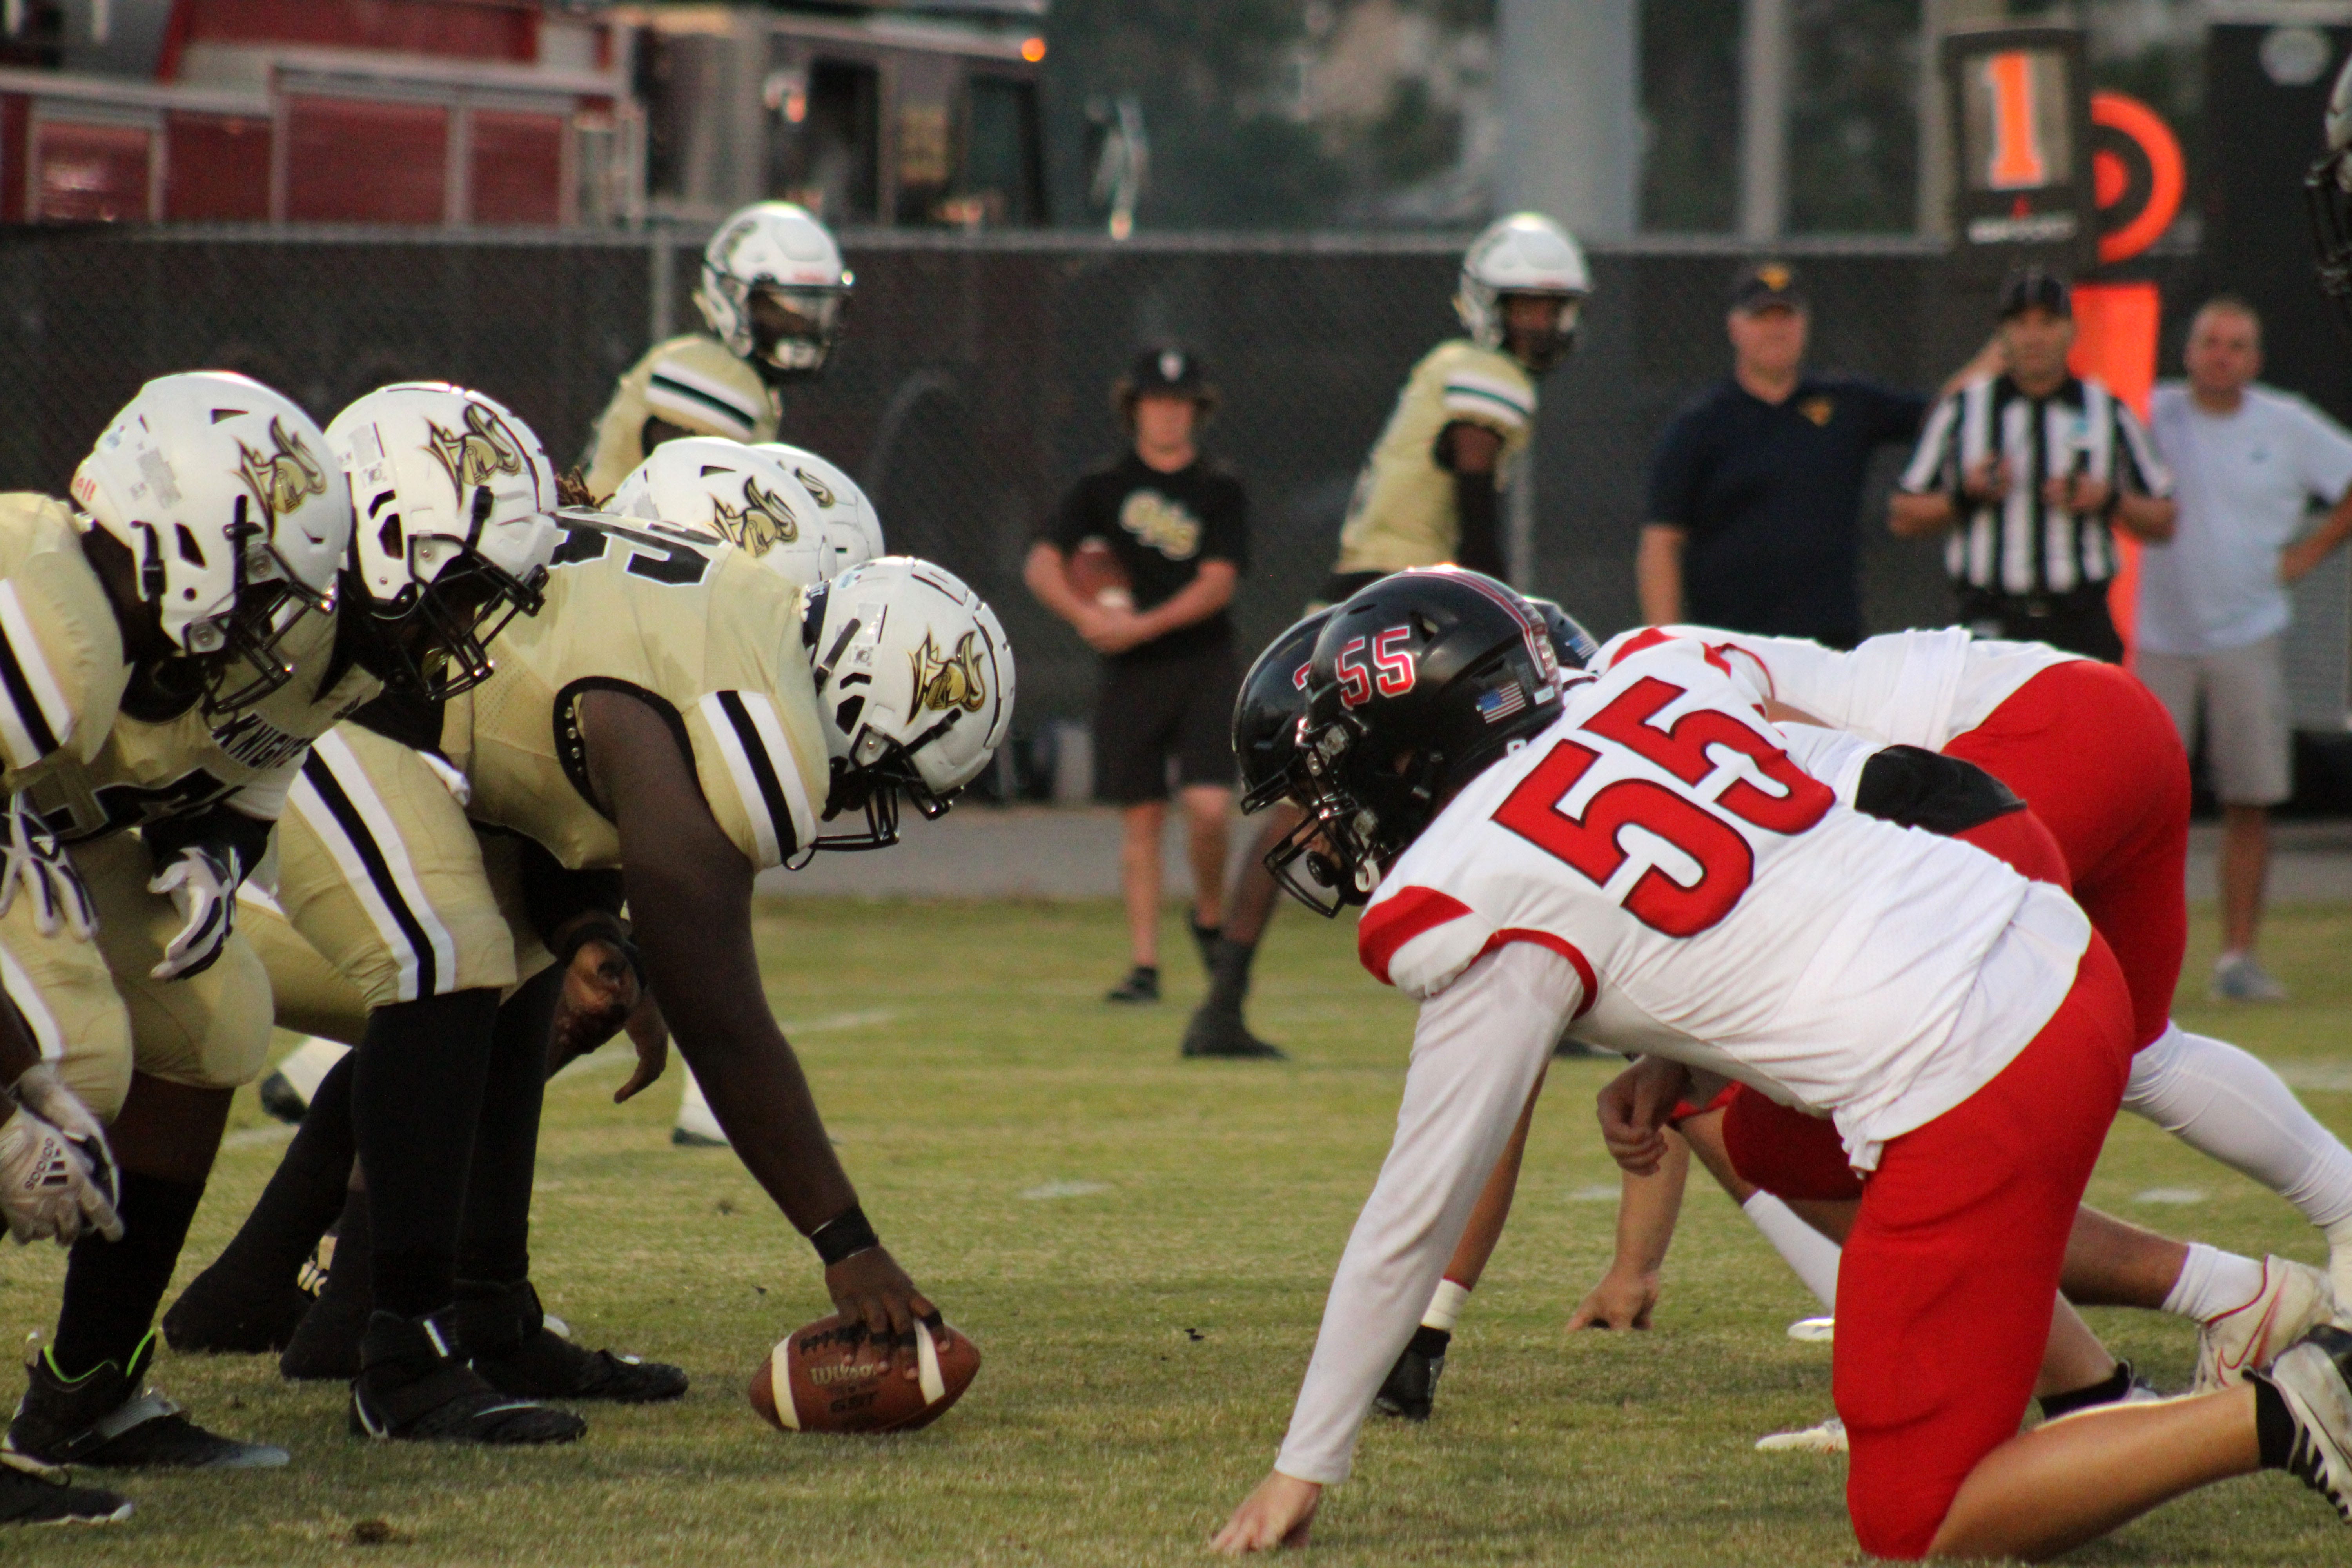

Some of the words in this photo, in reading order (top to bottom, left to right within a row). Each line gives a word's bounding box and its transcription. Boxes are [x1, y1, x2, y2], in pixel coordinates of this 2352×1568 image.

[1984, 50, 2044, 189] 1
[1334, 625, 1416, 711] 55
[1490, 676, 1836, 938] 55
[25, 1137, 54, 1191] adidas
